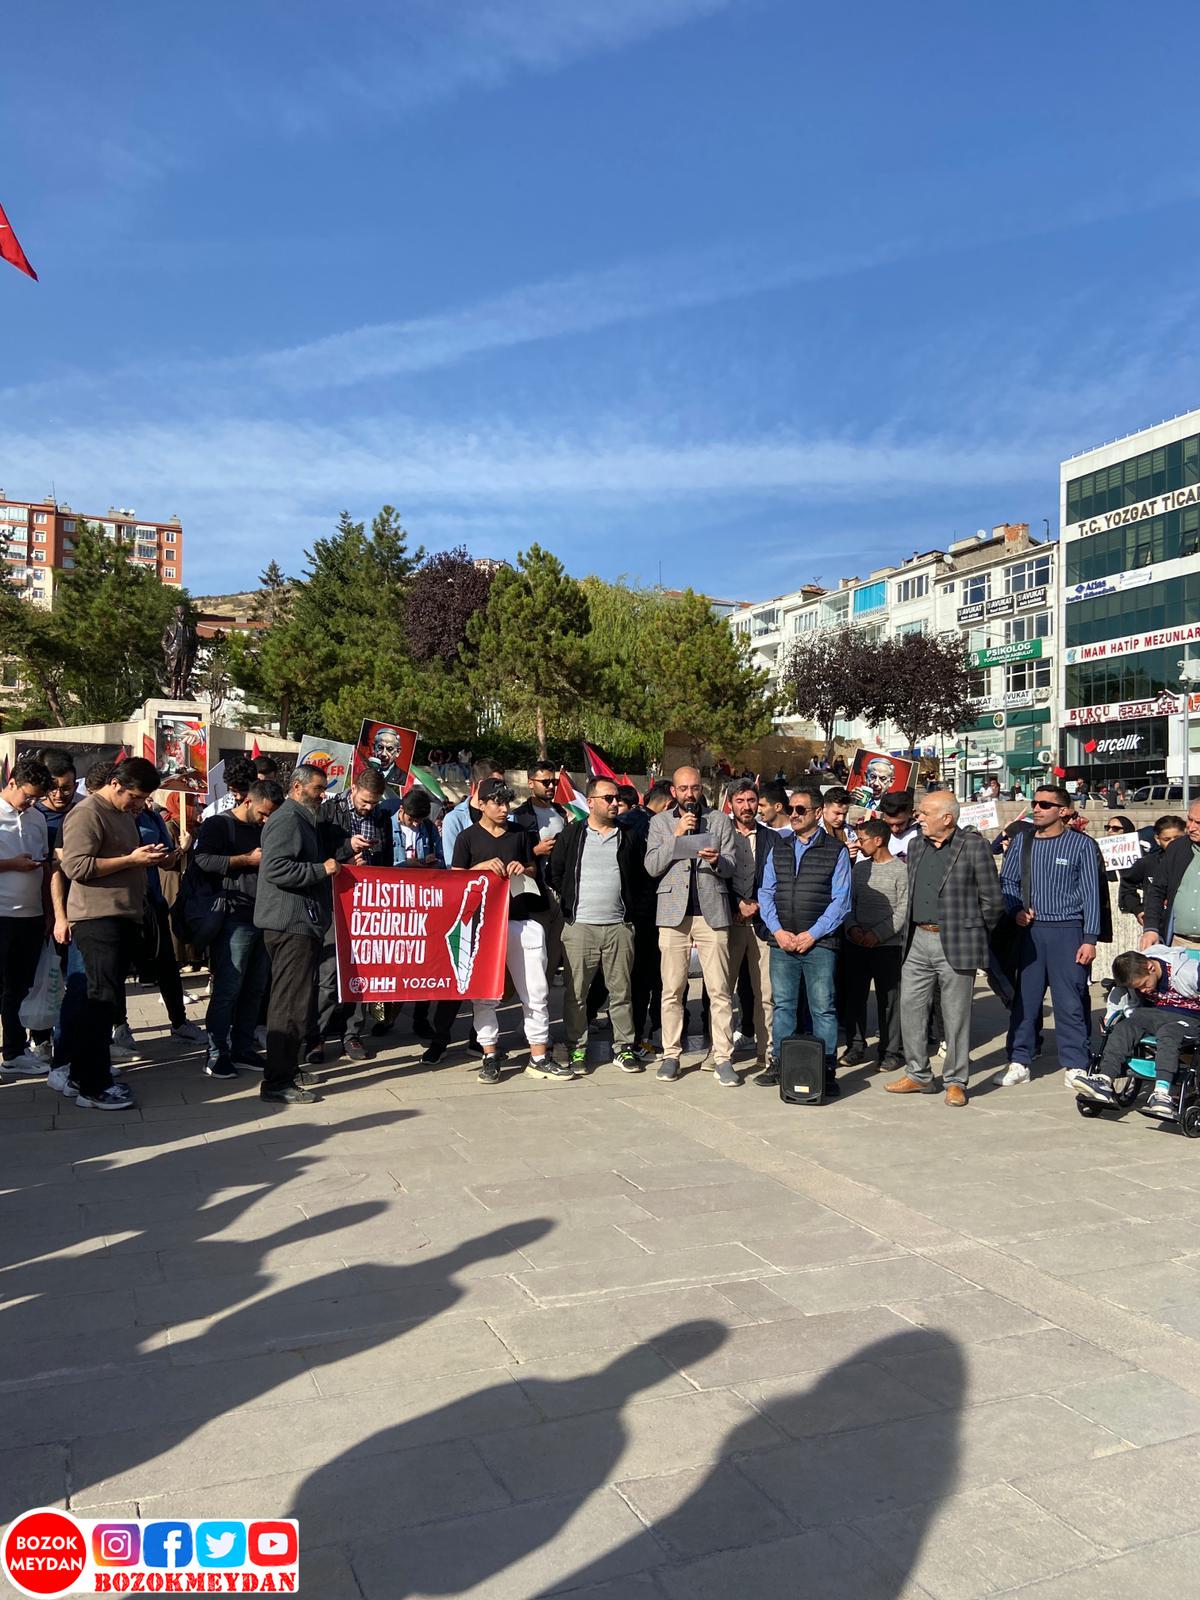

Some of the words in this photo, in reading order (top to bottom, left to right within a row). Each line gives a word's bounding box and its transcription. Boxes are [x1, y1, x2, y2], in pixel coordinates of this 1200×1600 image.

[1078, 519, 1101, 536] T.C.
[1104, 500, 1158, 528] YOZGAT
[991, 597, 1013, 608] AVUKAT
[1022, 589, 1045, 601] AVUKAT
[962, 604, 983, 615] AVUKAT
[986, 642, 1032, 658] PSİKOLOG
[1081, 645, 1106, 659] İMAM
[1110, 637, 1140, 653] HATİP
[1070, 705, 1110, 720] BURCU
[1096, 734, 1142, 755] arçelik
[352, 878, 416, 908] FİLİSTİN
[418, 885, 443, 911] İÇİN
[351, 908, 429, 937] ÖZGÜRLÜK
[350, 939, 427, 965] KONVOYU
[402, 977, 452, 989] YOZGAT
